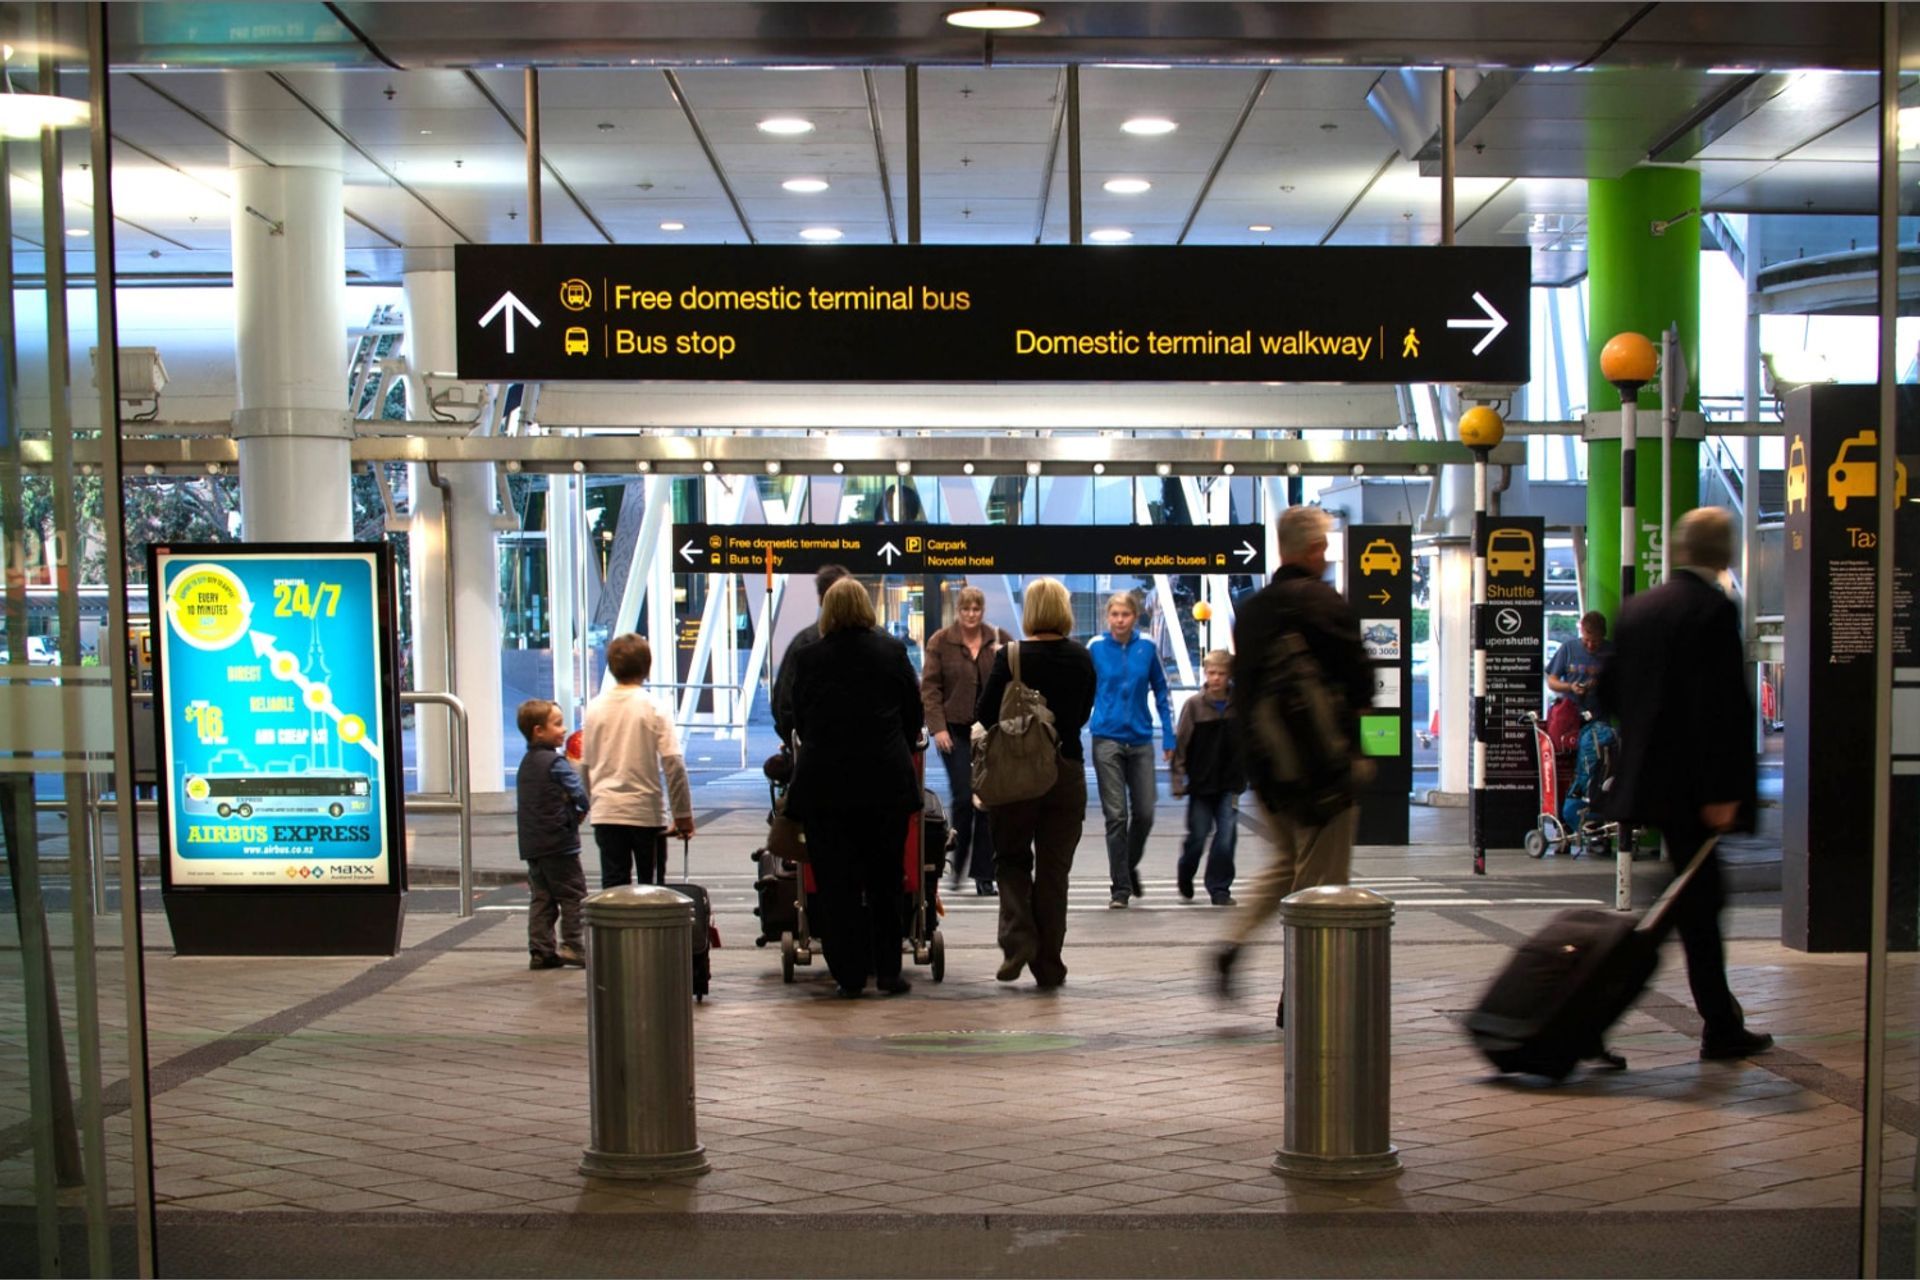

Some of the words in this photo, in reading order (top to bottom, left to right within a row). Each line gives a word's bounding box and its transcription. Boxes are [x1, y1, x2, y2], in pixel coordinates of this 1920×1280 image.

[615, 285, 672, 309] Free
[680, 285, 802, 310] domestic
[809, 285, 913, 310] terminal
[922, 285, 971, 310] bus
[615, 329, 668, 354] Bus
[676, 331, 736, 360] stop
[1016, 329, 1140, 355] Domestic
[1147, 329, 1252, 355] terminal
[1260, 330, 1372, 361] walkway
[728, 537, 751, 549] Free
[752, 537, 799, 549] domestic
[800, 538, 840, 549] terminal
[842, 538, 861, 550] bus
[926, 539, 967, 551] Carpark
[729, 554, 750, 565] Bus
[751, 554, 763, 565] to
[927, 555, 967, 566] Novotel
[968, 556, 994, 566] hotel
[1114, 554, 1142, 566] Other
[1144, 554, 1175, 568] public
[1176, 555, 1207, 566] buses
[198, 592, 219, 603] EVERY
[1487, 584, 1536, 598] Shuttle
[274, 582, 342, 620] 24/7
[187, 604, 195, 616] 10
[196, 604, 228, 616] MINUTES
[1485, 636, 1540, 648] upershuttle
[1379, 648, 1399, 656] 3000
[227, 665, 261, 682] DIRECT
[249, 696, 294, 713] RELIABLE
[187, 825, 269, 843] AIRBUS
[273, 825, 371, 843] EXPRESS
[243, 845, 314, 855] www.airbus.co.nz
